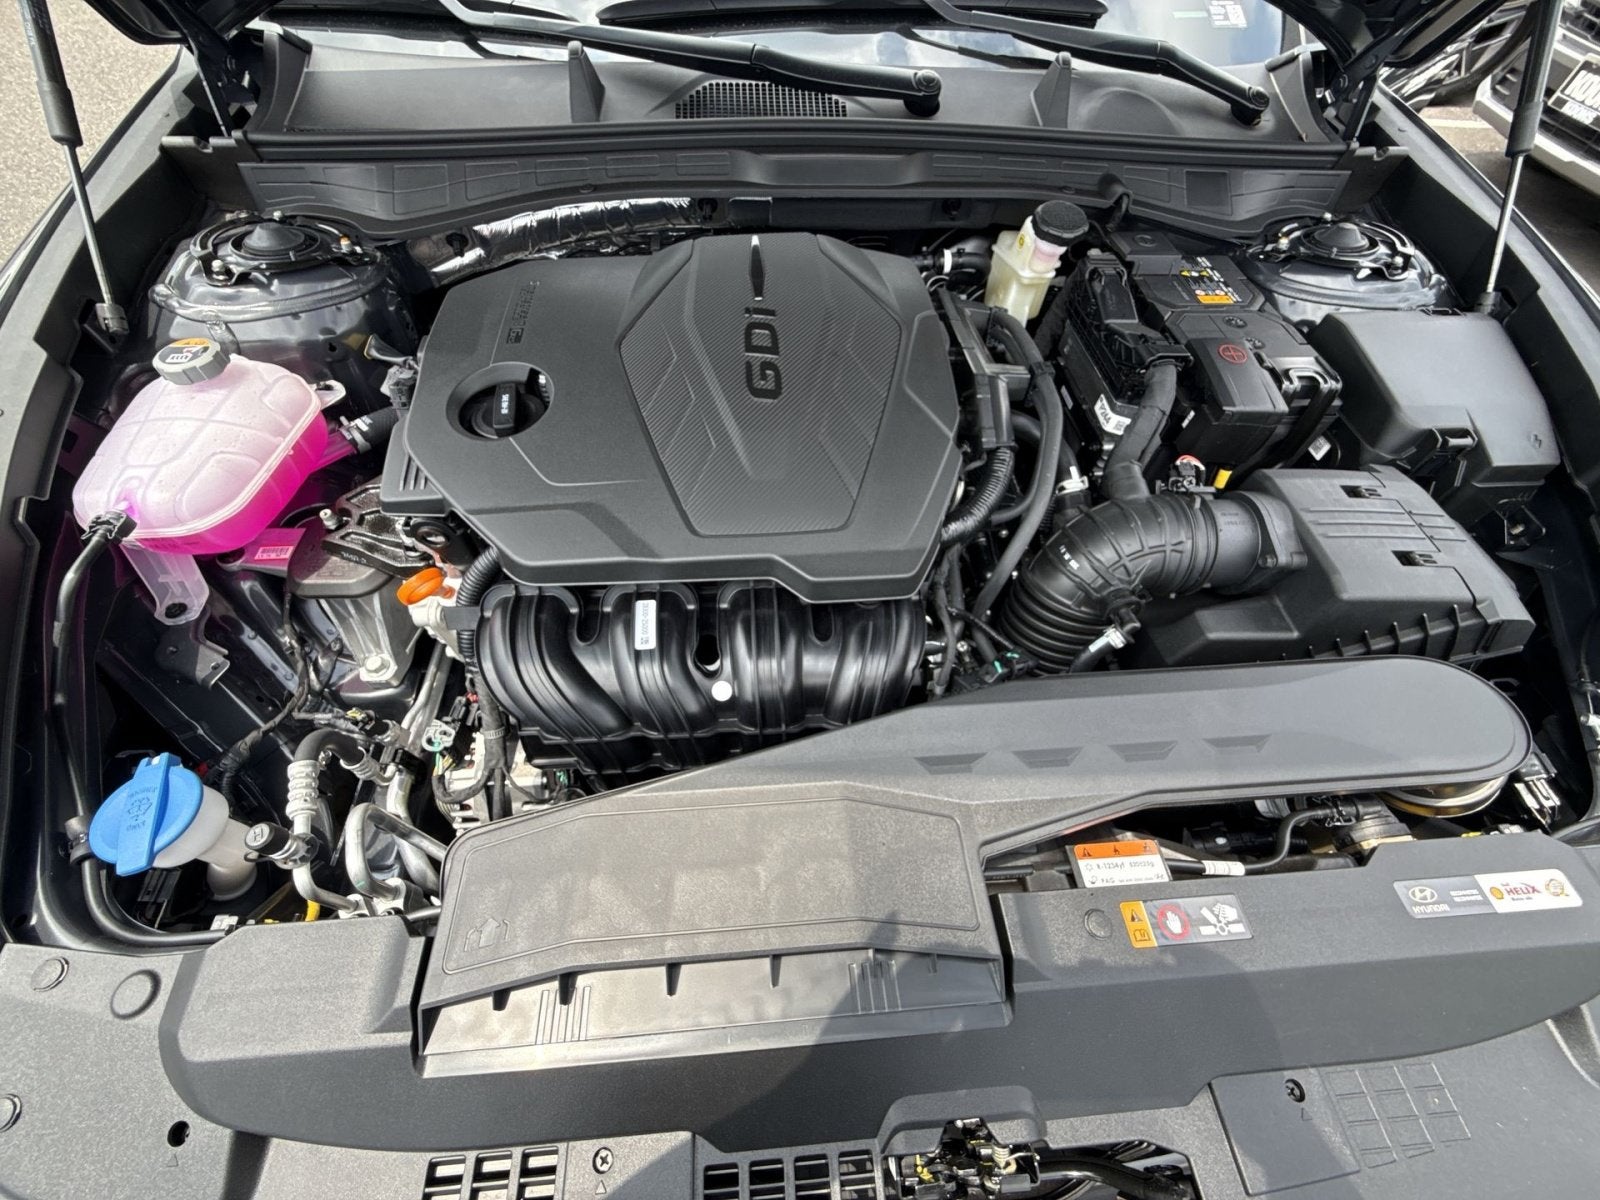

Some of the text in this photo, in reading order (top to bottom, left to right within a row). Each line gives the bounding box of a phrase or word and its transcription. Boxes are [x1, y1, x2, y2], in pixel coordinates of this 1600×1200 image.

[744, 307, 782, 400] GDi
[1505, 883, 1541, 896] HELIX
[1412, 904, 1450, 914] HYUNDAI
